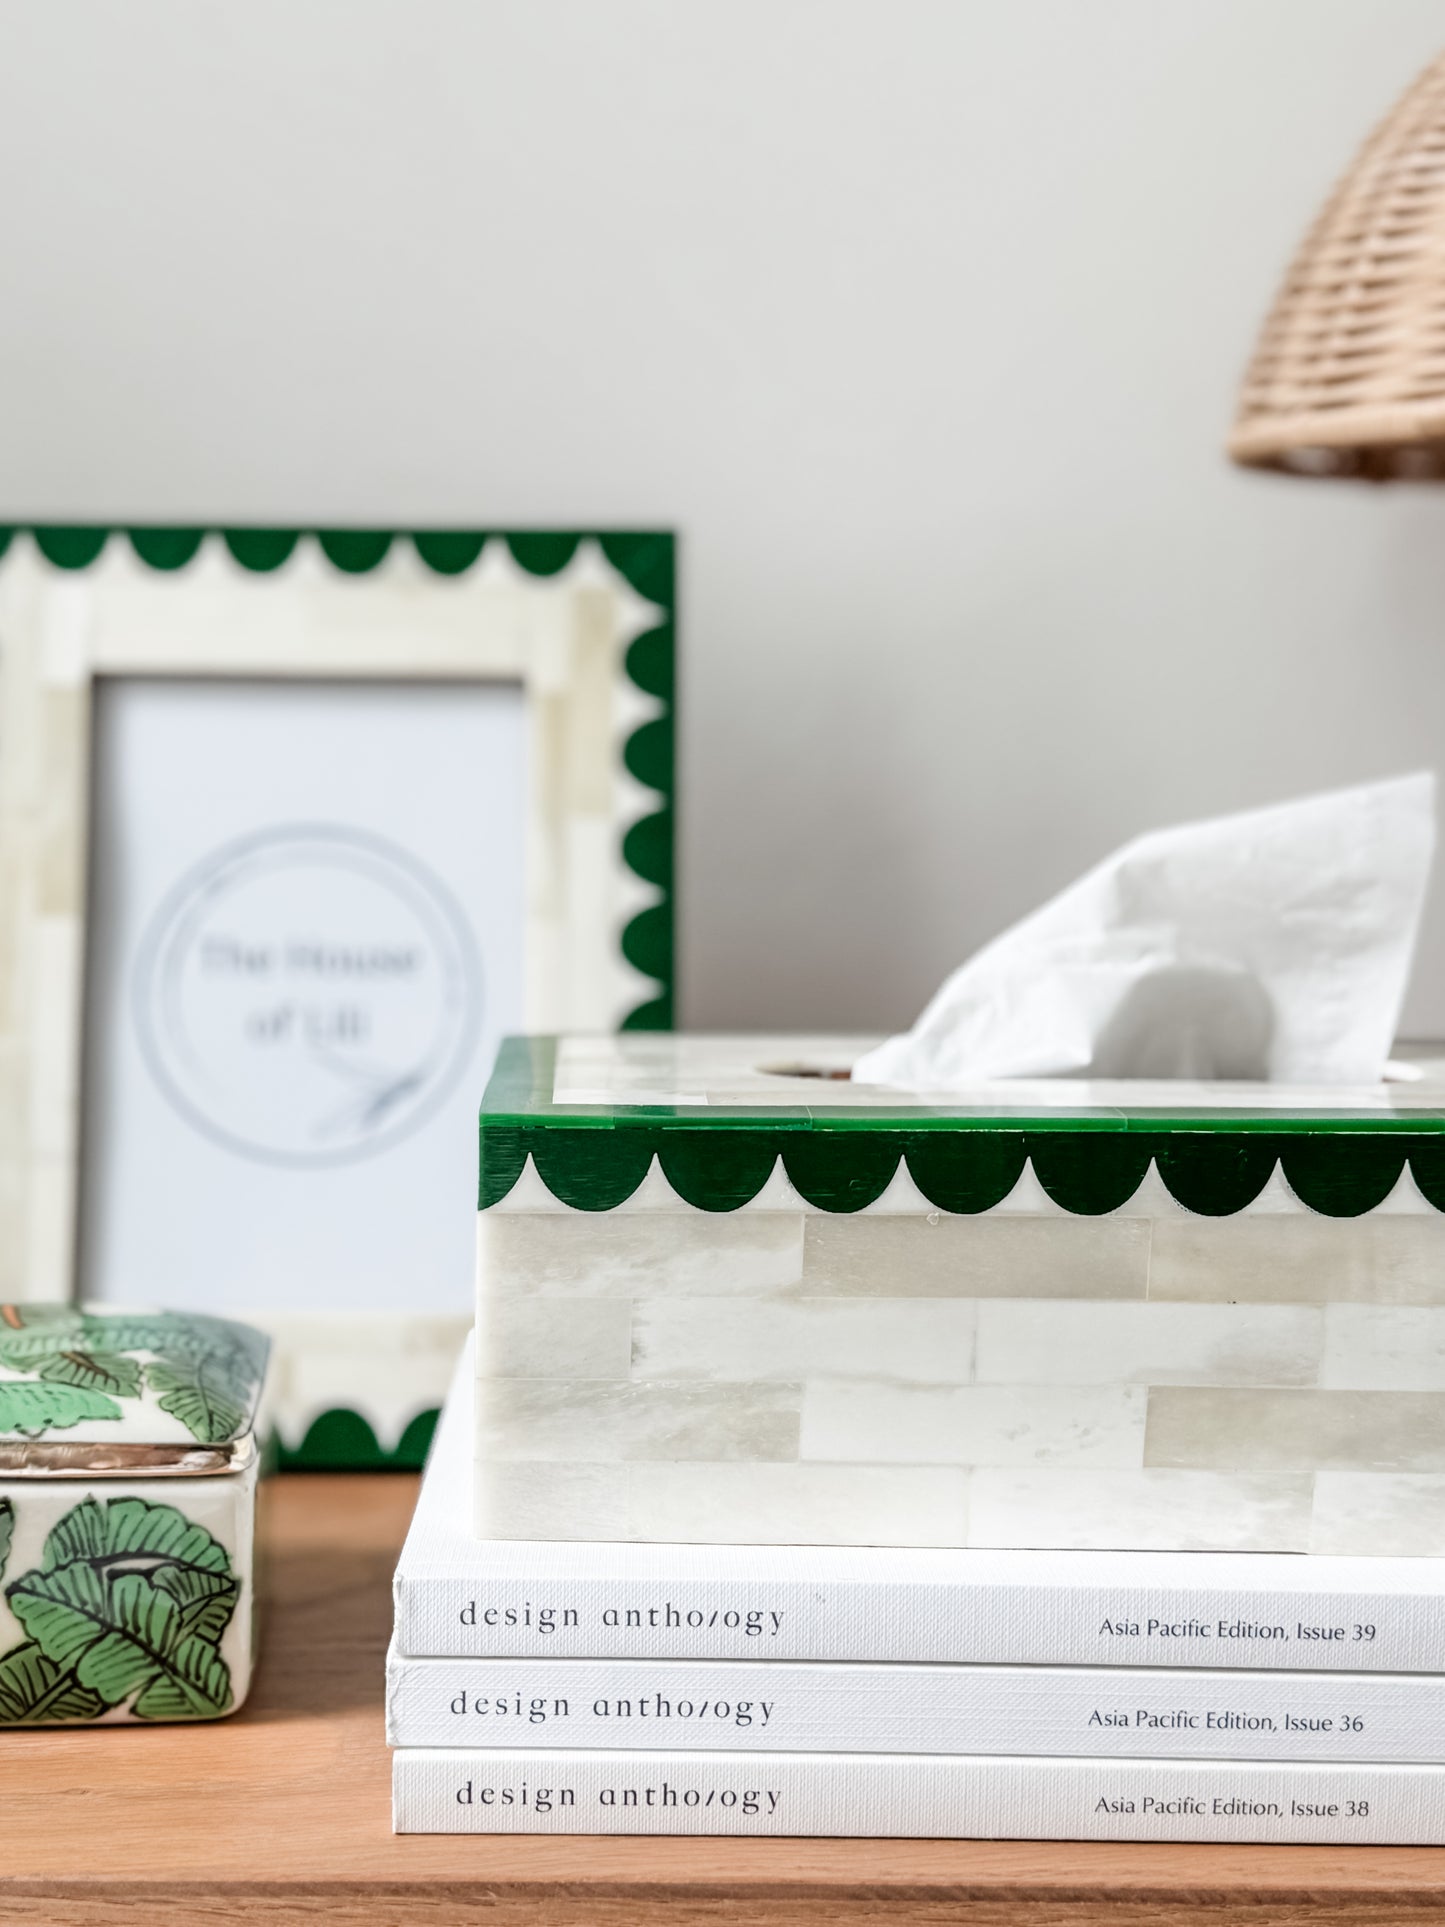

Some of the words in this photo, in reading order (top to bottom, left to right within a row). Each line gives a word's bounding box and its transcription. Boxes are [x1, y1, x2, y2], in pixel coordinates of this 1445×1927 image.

[459, 1600, 579, 1634] design
[1098, 1618, 1140, 1636] Asia
[1147, 1618, 1211, 1638] Pacific
[1217, 1619, 1289, 1642] Edition,
[1297, 1622, 1346, 1641] Issue
[1351, 1624, 1377, 1642] 39
[450, 1690, 569, 1724] design
[1088, 1709, 1129, 1727] Asia
[1136, 1709, 1200, 1728] Pacific
[1206, 1710, 1278, 1733] Edition,
[1285, 1713, 1333, 1732] Issue
[1339, 1714, 1364, 1733] 36
[456, 1780, 575, 1813] design
[1094, 1796, 1136, 1814] Asia
[1142, 1796, 1206, 1815] Pacific
[1212, 1797, 1284, 1819] Edition,
[1291, 1799, 1339, 1817] Issue
[1344, 1800, 1369, 1818] 38
